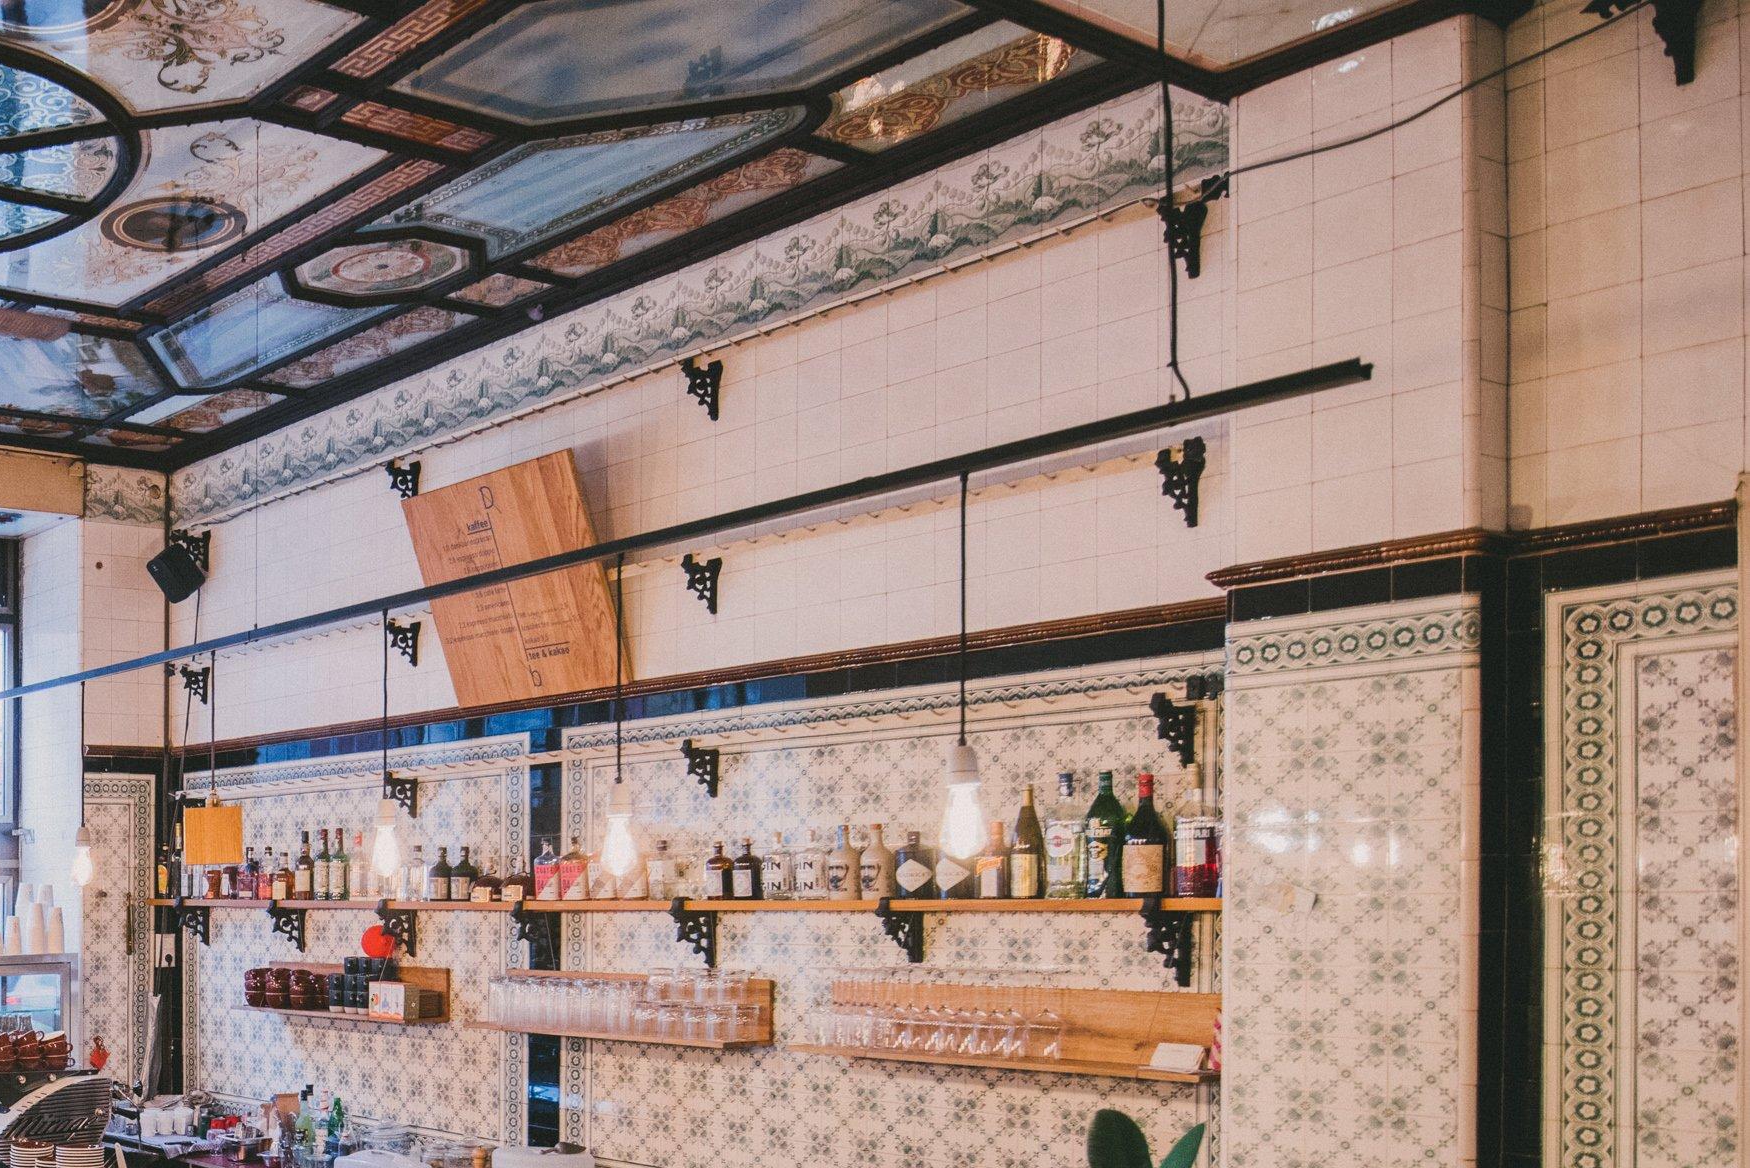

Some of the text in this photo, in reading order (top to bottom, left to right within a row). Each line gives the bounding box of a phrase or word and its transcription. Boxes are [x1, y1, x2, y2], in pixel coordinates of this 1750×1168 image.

[467, 519, 489, 532] kaffee
[528, 645, 571, 661] tee & kakao
